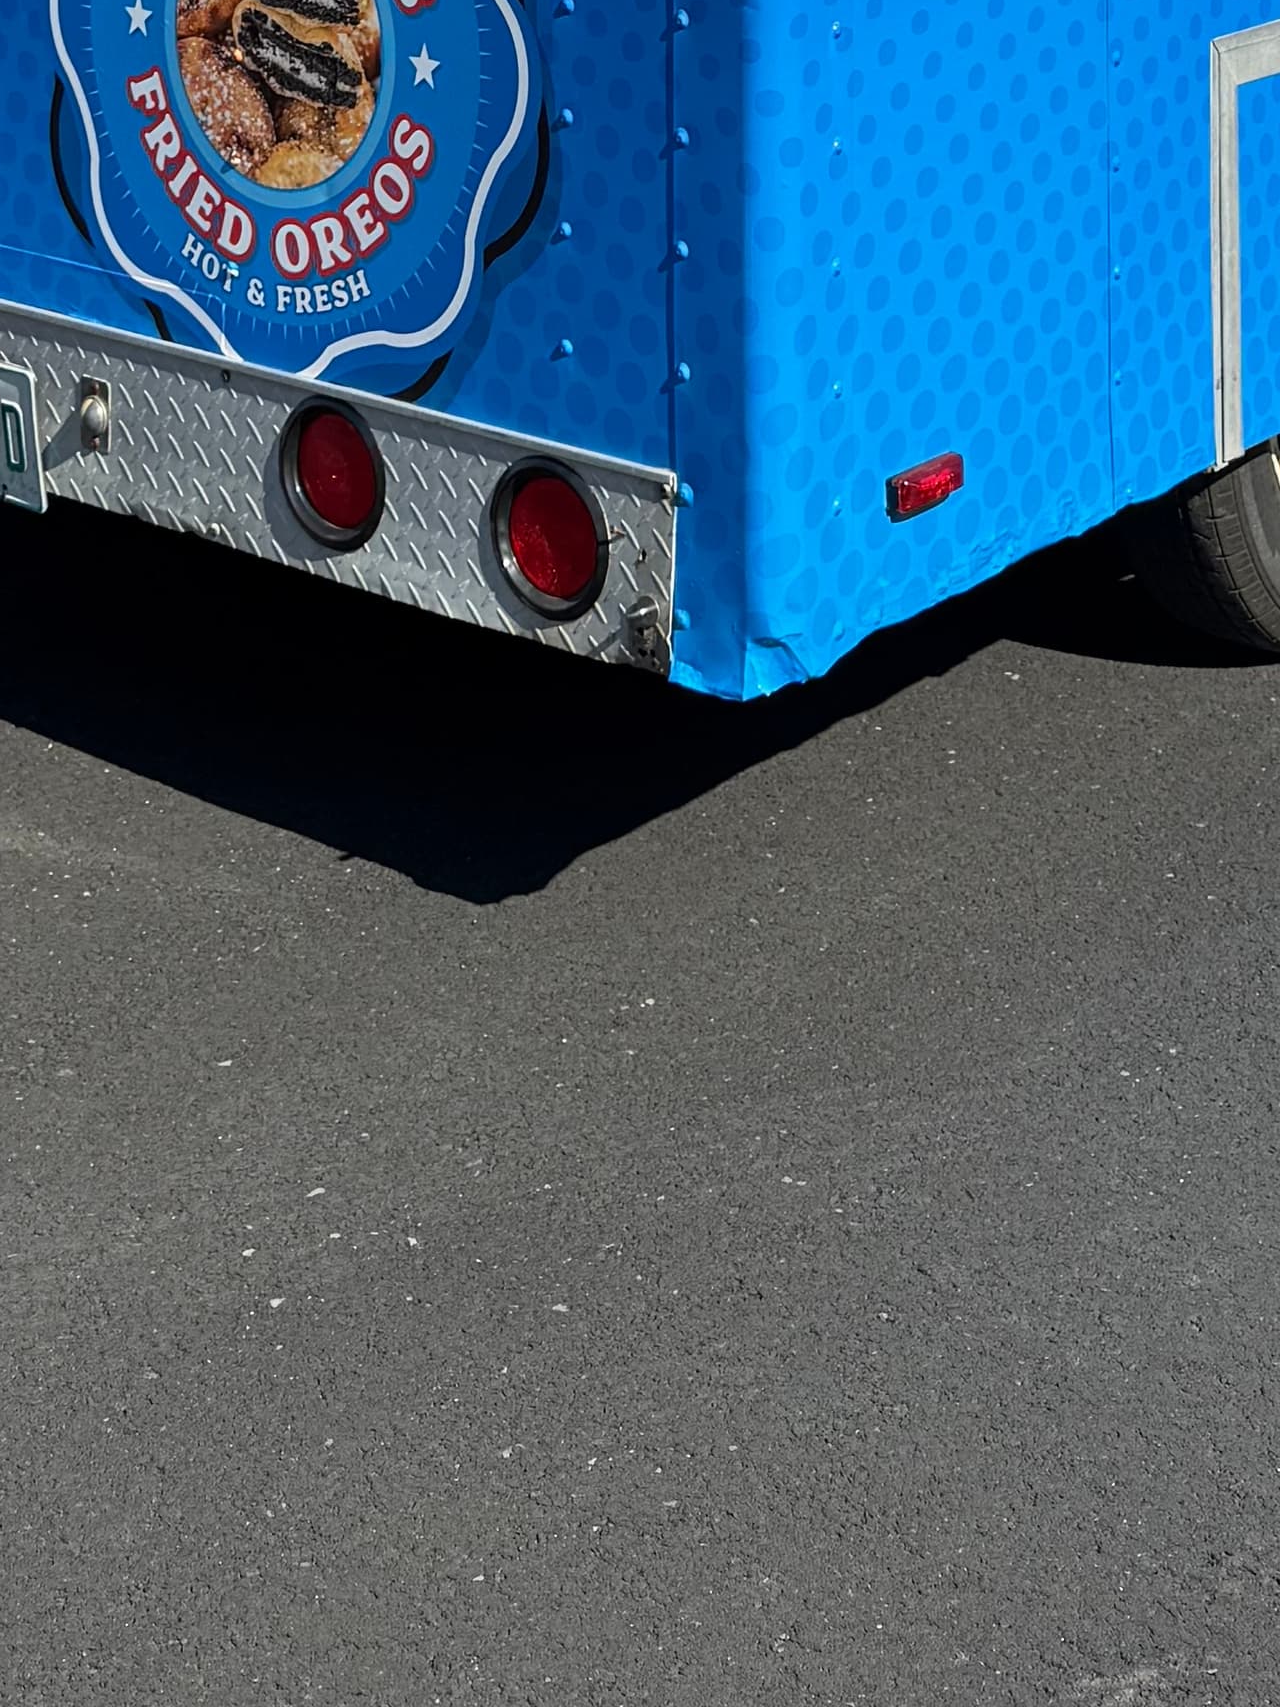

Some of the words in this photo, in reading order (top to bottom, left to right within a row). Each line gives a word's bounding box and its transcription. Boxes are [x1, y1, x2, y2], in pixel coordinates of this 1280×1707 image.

[126, 65, 254, 263] FRIED
[272, 113, 434, 281] OREOS
[181, 232, 240, 295] HOT
[246, 281, 265, 307] &
[276, 268, 372, 316] FRESH
